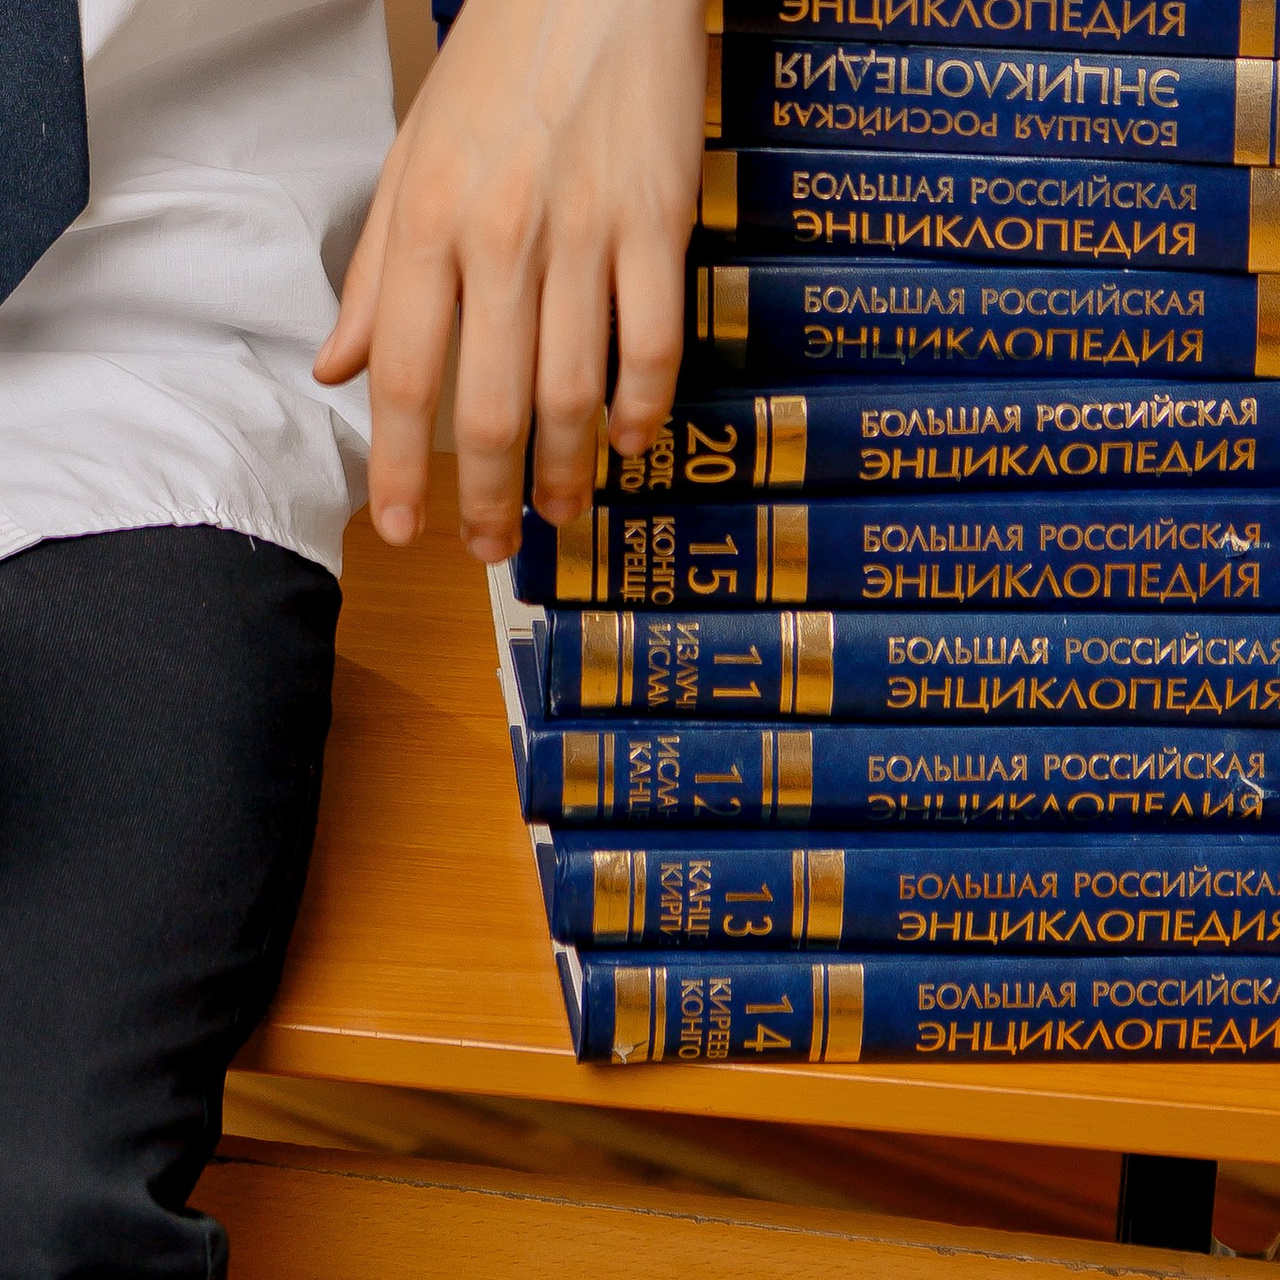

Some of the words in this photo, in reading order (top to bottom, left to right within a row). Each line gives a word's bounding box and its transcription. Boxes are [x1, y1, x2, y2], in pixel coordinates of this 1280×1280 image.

[774, 46, 1180, 108] ЭНЦИКЛОПЕДИЯ
[772, 100, 998, 137] РОССИЙСКАЯ
[1014, 113, 1179, 147] БОЛЬШАЯ
[792, 171, 954, 204] БОЛЬШАЯ
[970, 174, 1197, 210] РОССИЙСКАЯ
[792, 209, 1196, 259] ЭНЦИКЛОПЕДИЯ
[803, 285, 966, 316] БОЛЬШАЯ
[980, 283, 1205, 316] РОССИЙСКАЯ
[803, 324, 1204, 368] ЭНЦИКЛОПЕДИЯ
[861, 405, 1022, 438] БОЛЬШАЯ
[1036, 394, 1258, 432] РОССИЙСКАЯ
[684, 421, 738, 484] 20
[859, 438, 1256, 482] ЭНЦИКЛОПЕДИЯ
[862, 523, 1023, 553] БОЛЬШАЯ
[1039, 517, 1261, 552] РОССИЙСКАЯ
[650, 515, 676, 606] КОНГО
[687, 533, 739, 595] 15
[862, 562, 1260, 604] ЭНЦИКЛОПЕДИЯ
[712, 643, 763, 698] 11
[888, 636, 1049, 666] БОЛЬШАЯ
[886, 676, 1280, 715] ЭНЦИКЛОПЕДИЯ
[867, 753, 1028, 783] БОЛЬШАЯ
[1044, 746, 1265, 782] РОССИЙСКАЯ
[693, 763, 743, 817] 12
[899, 872, 1058, 900] БОЛЬШАЯ
[1073, 865, 1280, 899] РОССИЙСКА
[722, 880, 774, 938] 13
[918, 981, 1076, 1010] БОЛЬШАЯ
[678, 978, 704, 1059] КОНГО
[743, 993, 794, 1053] 14
